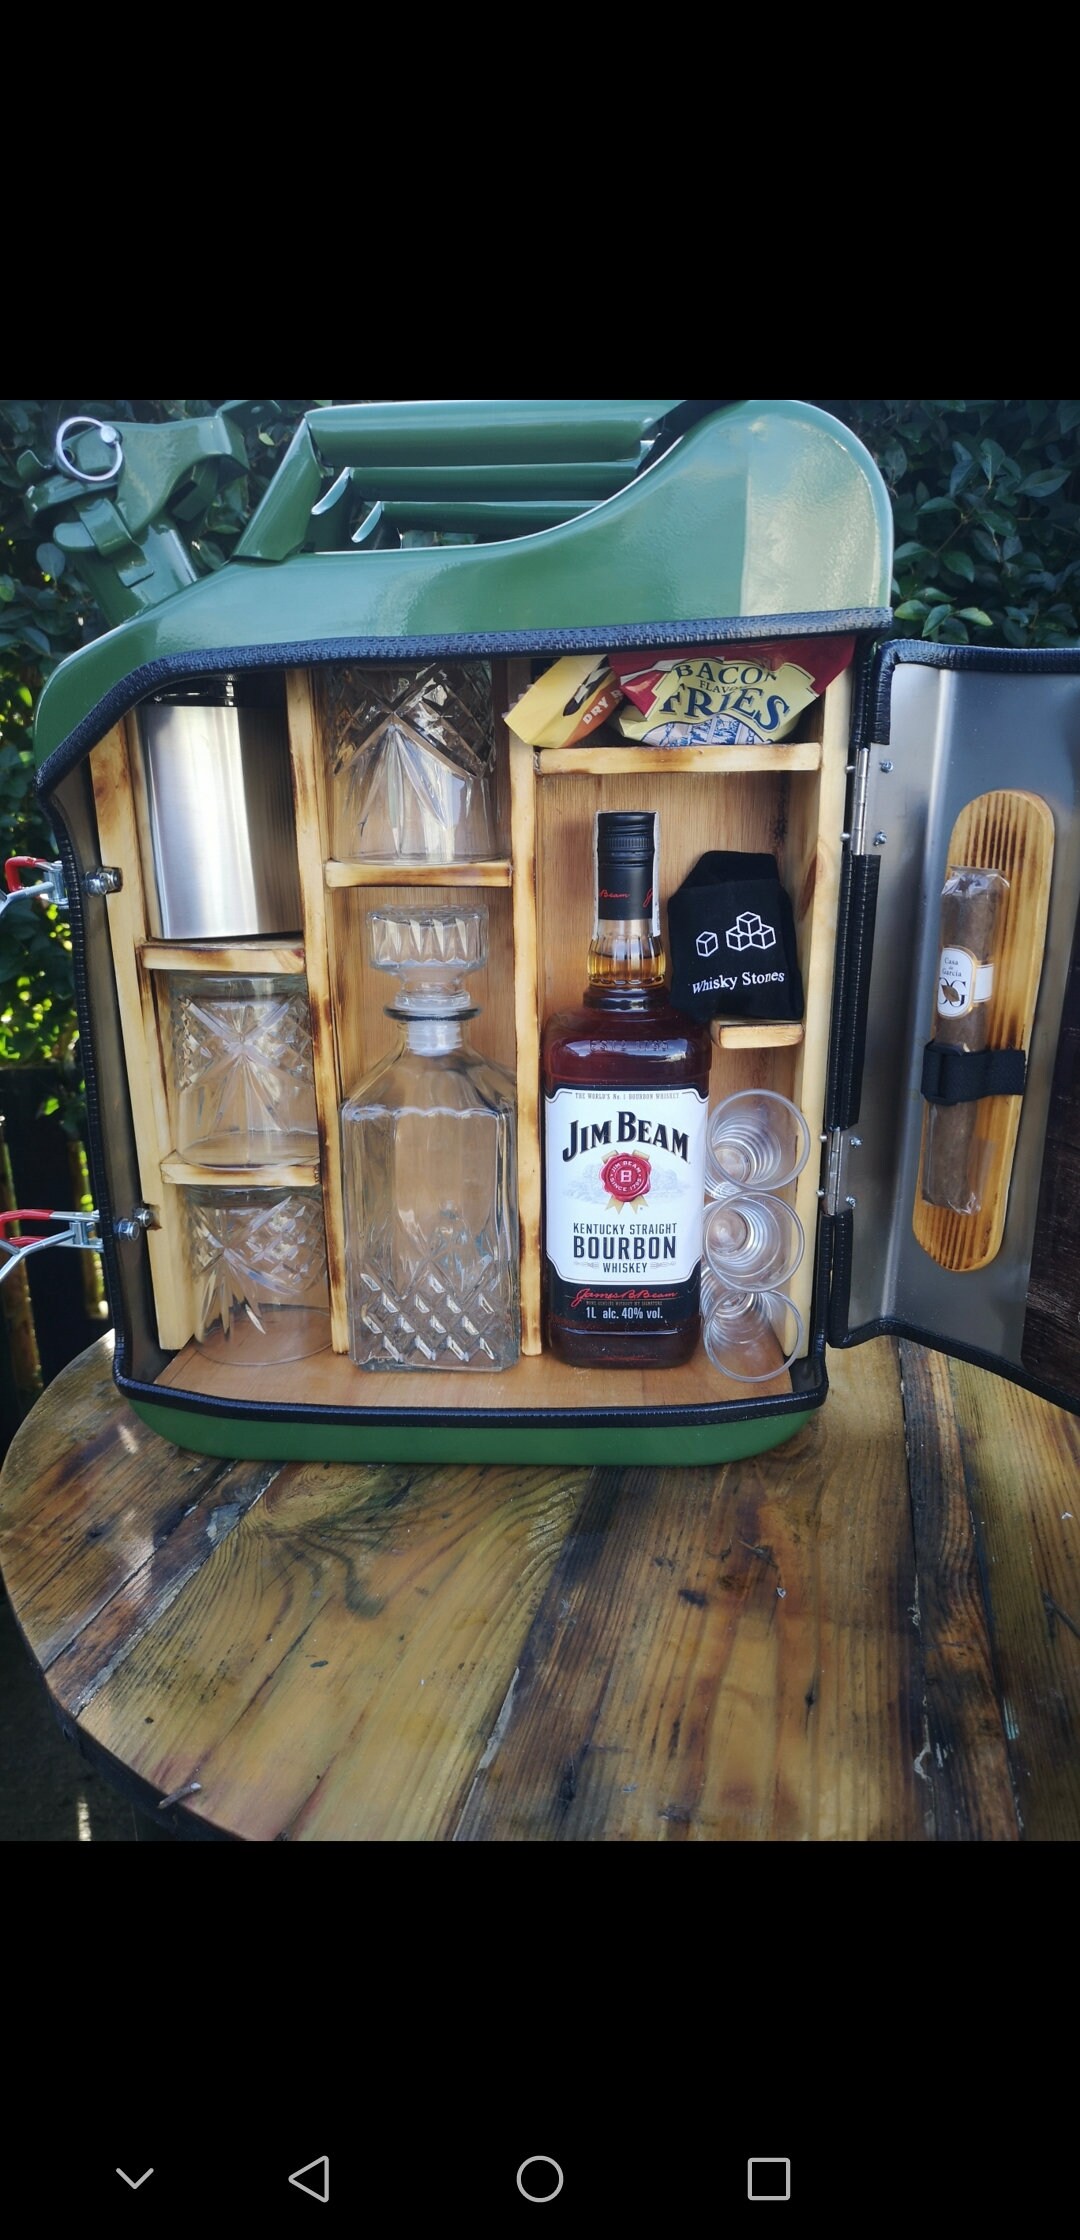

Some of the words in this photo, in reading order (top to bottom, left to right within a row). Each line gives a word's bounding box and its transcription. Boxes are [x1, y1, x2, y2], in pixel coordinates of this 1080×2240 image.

[674, 661, 777, 685] BACON
[582, 696, 609, 725] DRY
[659, 683, 790, 731] FRIES
[944, 957, 959, 965] Casa
[692, 974, 738, 995] Whisky
[741, 971, 785, 986] Stones
[616, 1110, 690, 1163] BEAM
[573, 1222, 625, 1235] KENTUCKY
[629, 1222, 677, 1235] STRAIGHT
[573, 1235, 676, 1260] BOURBON
[602, 1262, 648, 1273] WHISKEY
[586, 1306, 597, 1319] 1L
[602, 1307, 619, 1319] alc.
[621, 1307, 644, 1319] 40%
[646, 1307, 663, 1319] vol.
